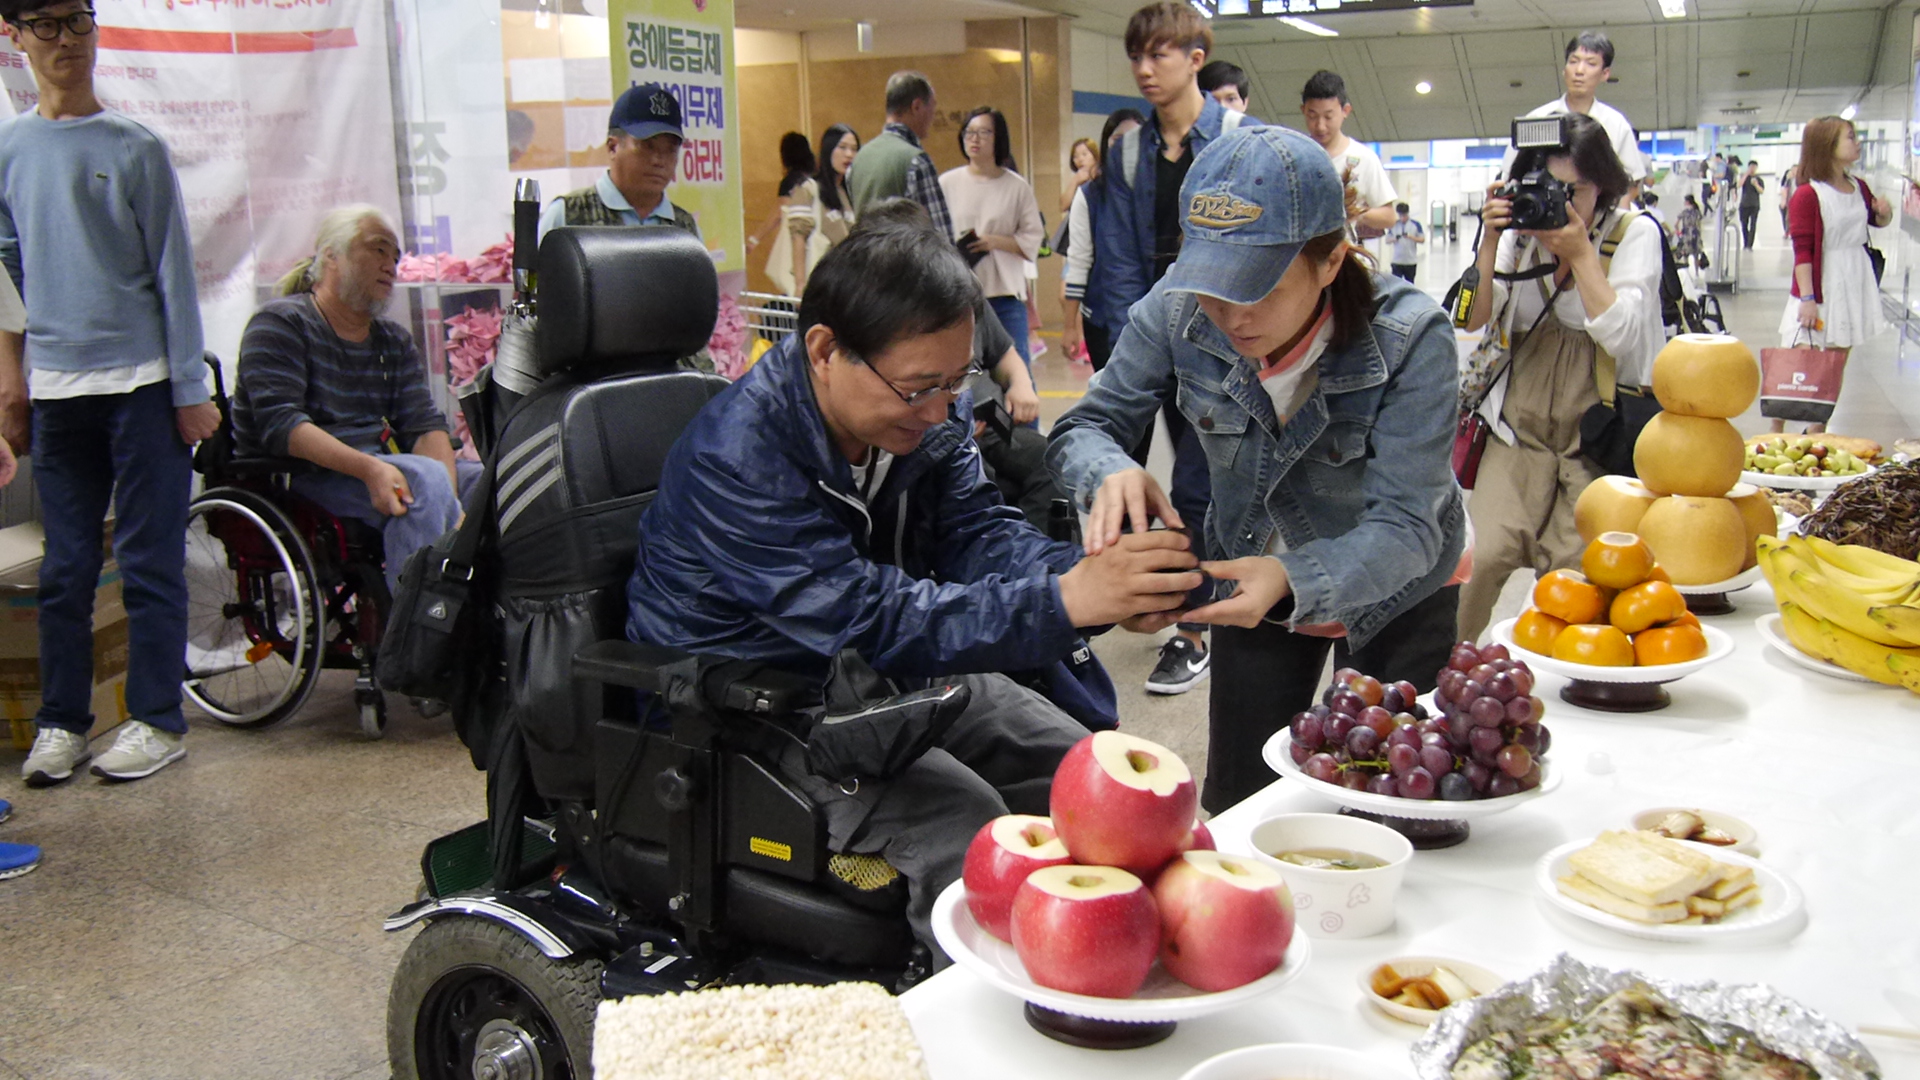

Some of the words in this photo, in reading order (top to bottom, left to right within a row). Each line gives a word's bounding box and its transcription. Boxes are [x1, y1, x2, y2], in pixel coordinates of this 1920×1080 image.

[627, 22, 722, 75] 장애등급제
[682, 138, 723, 183] 하라!
[1457, 288, 1473, 320] Nikon
